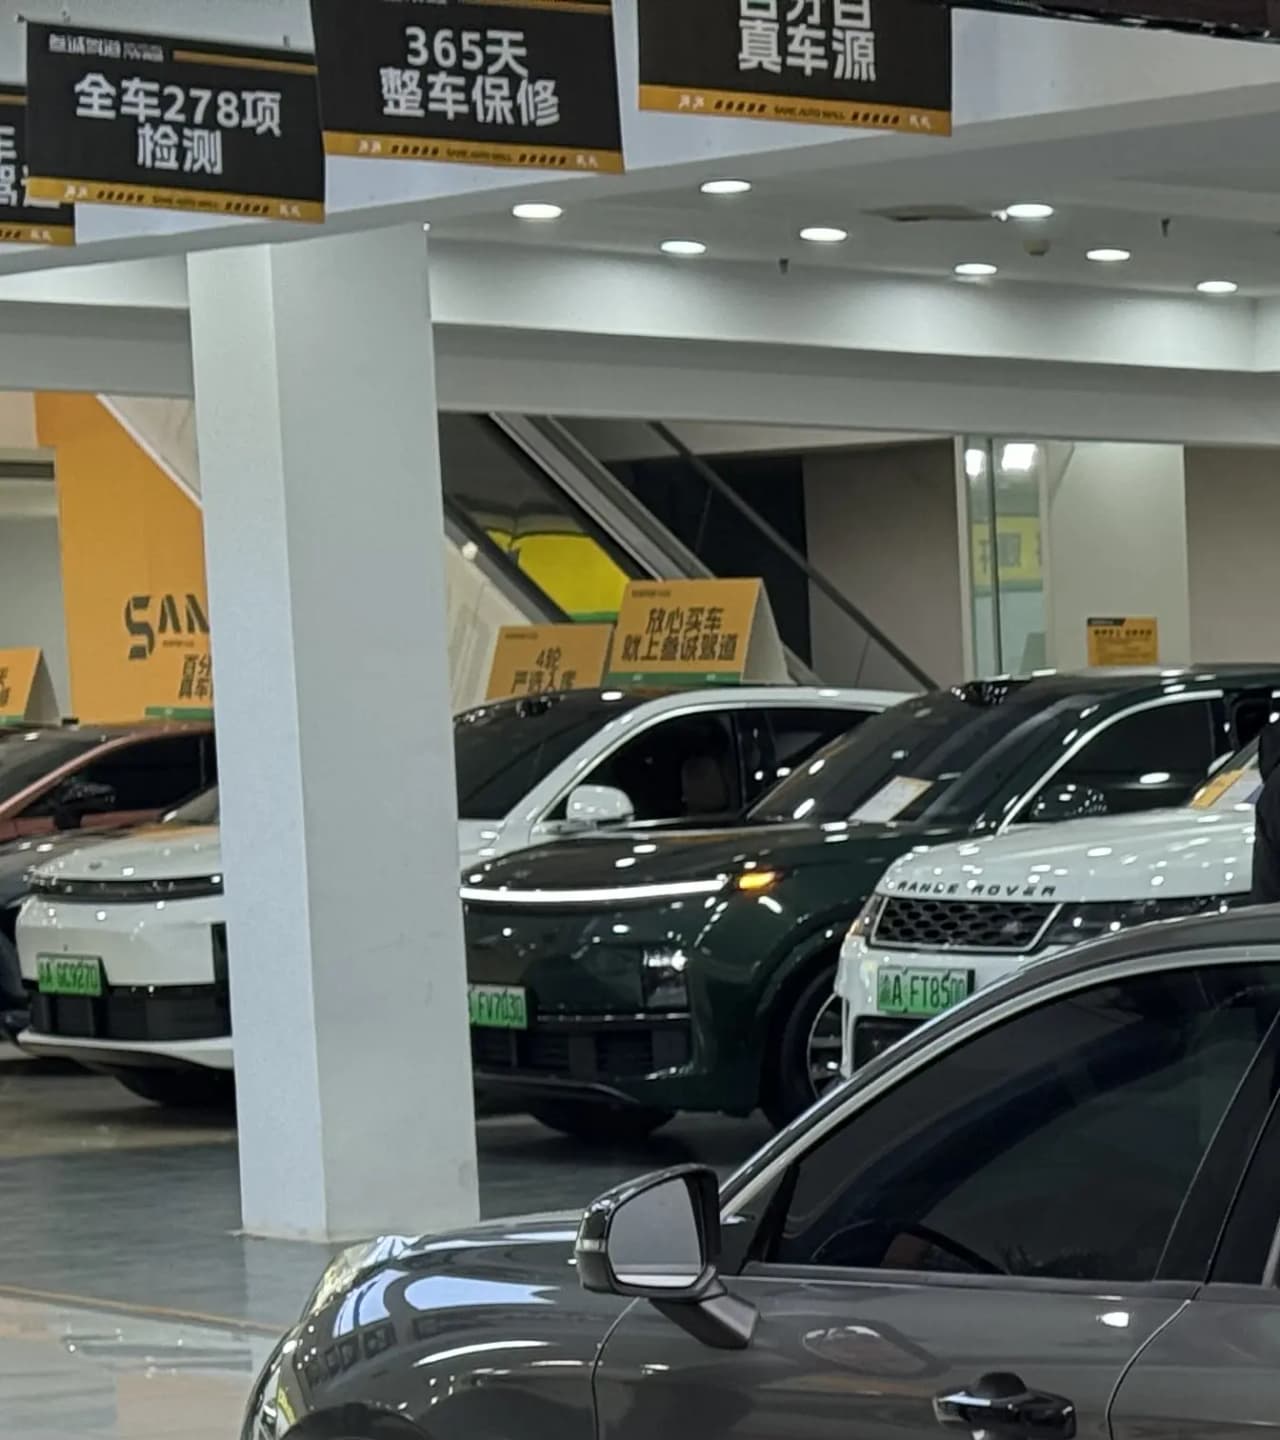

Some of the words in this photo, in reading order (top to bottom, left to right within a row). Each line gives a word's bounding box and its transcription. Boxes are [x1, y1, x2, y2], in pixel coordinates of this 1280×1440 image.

[405, 26, 528, 78] 365天
[738, 19, 876, 81] 真车源
[74, 72, 282, 137] 全车278项
[380, 66, 560, 127] 整车保修
[136, 122, 223, 175] 检测
[646, 606, 724, 635] 放心买车
[897, 879, 959, 895] RANGE
[971, 883, 1057, 897] ROVER
